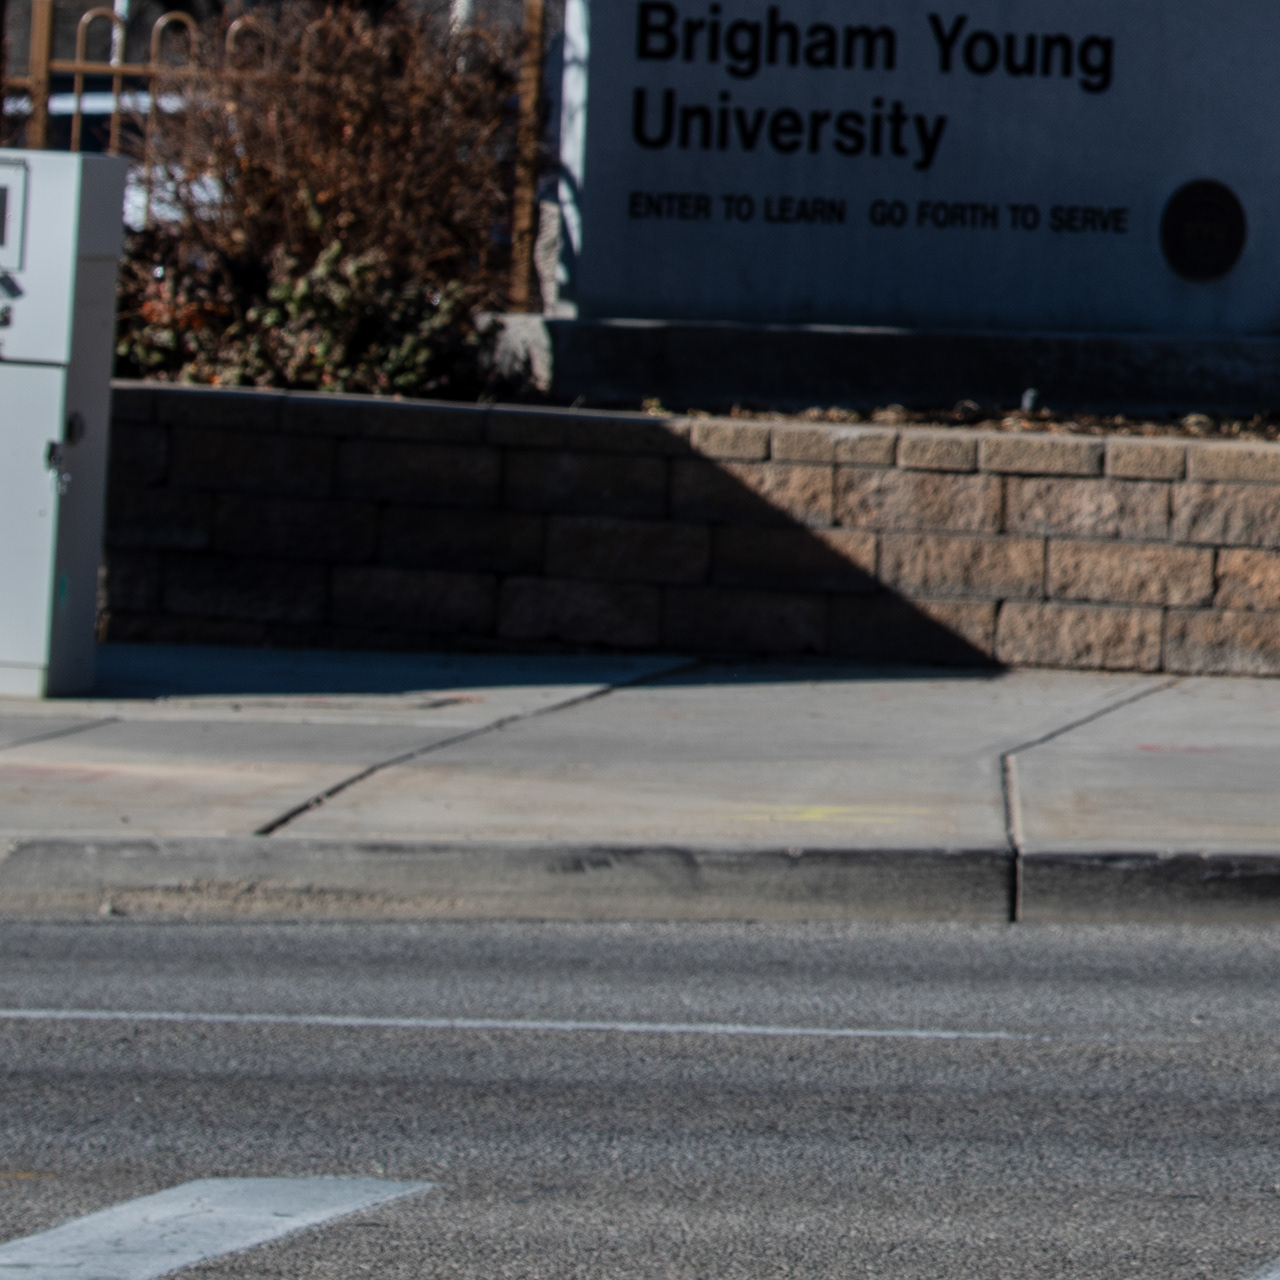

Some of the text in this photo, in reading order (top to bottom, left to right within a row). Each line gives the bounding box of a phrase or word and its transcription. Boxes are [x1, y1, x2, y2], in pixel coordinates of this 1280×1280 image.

[636, 1, 1115, 94] Brigham Young
[632, 88, 947, 171] University
[628, 191, 1130, 234] ENTER TO LEARN GO FORTH TO SERVE
